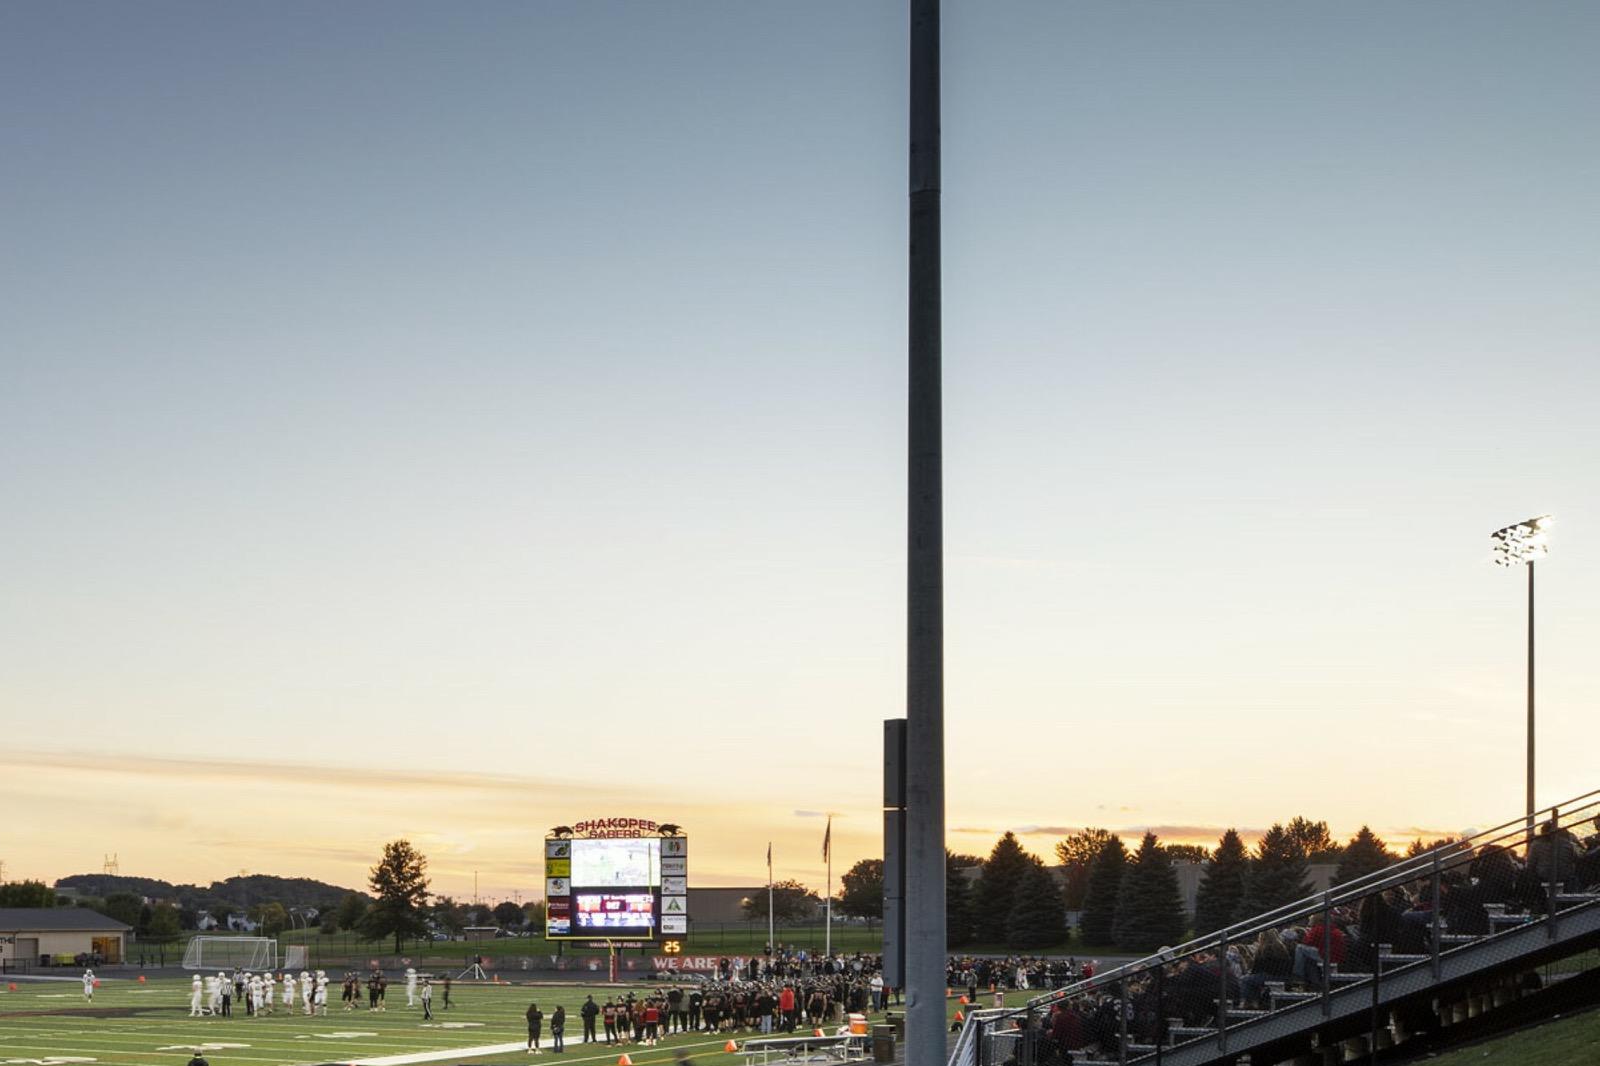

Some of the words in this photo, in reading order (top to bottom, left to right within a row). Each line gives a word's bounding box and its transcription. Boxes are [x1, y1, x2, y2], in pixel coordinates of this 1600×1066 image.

[575, 818, 656, 832] SHAKOPEE
[589, 830, 641, 839] SABERS
[0, 936, 15, 945] THE
[623, 941, 642, 949] FIELD
[664, 941, 680, 953] 25
[653, 957, 679, 969] WE
[682, 957, 716, 969] ARE
